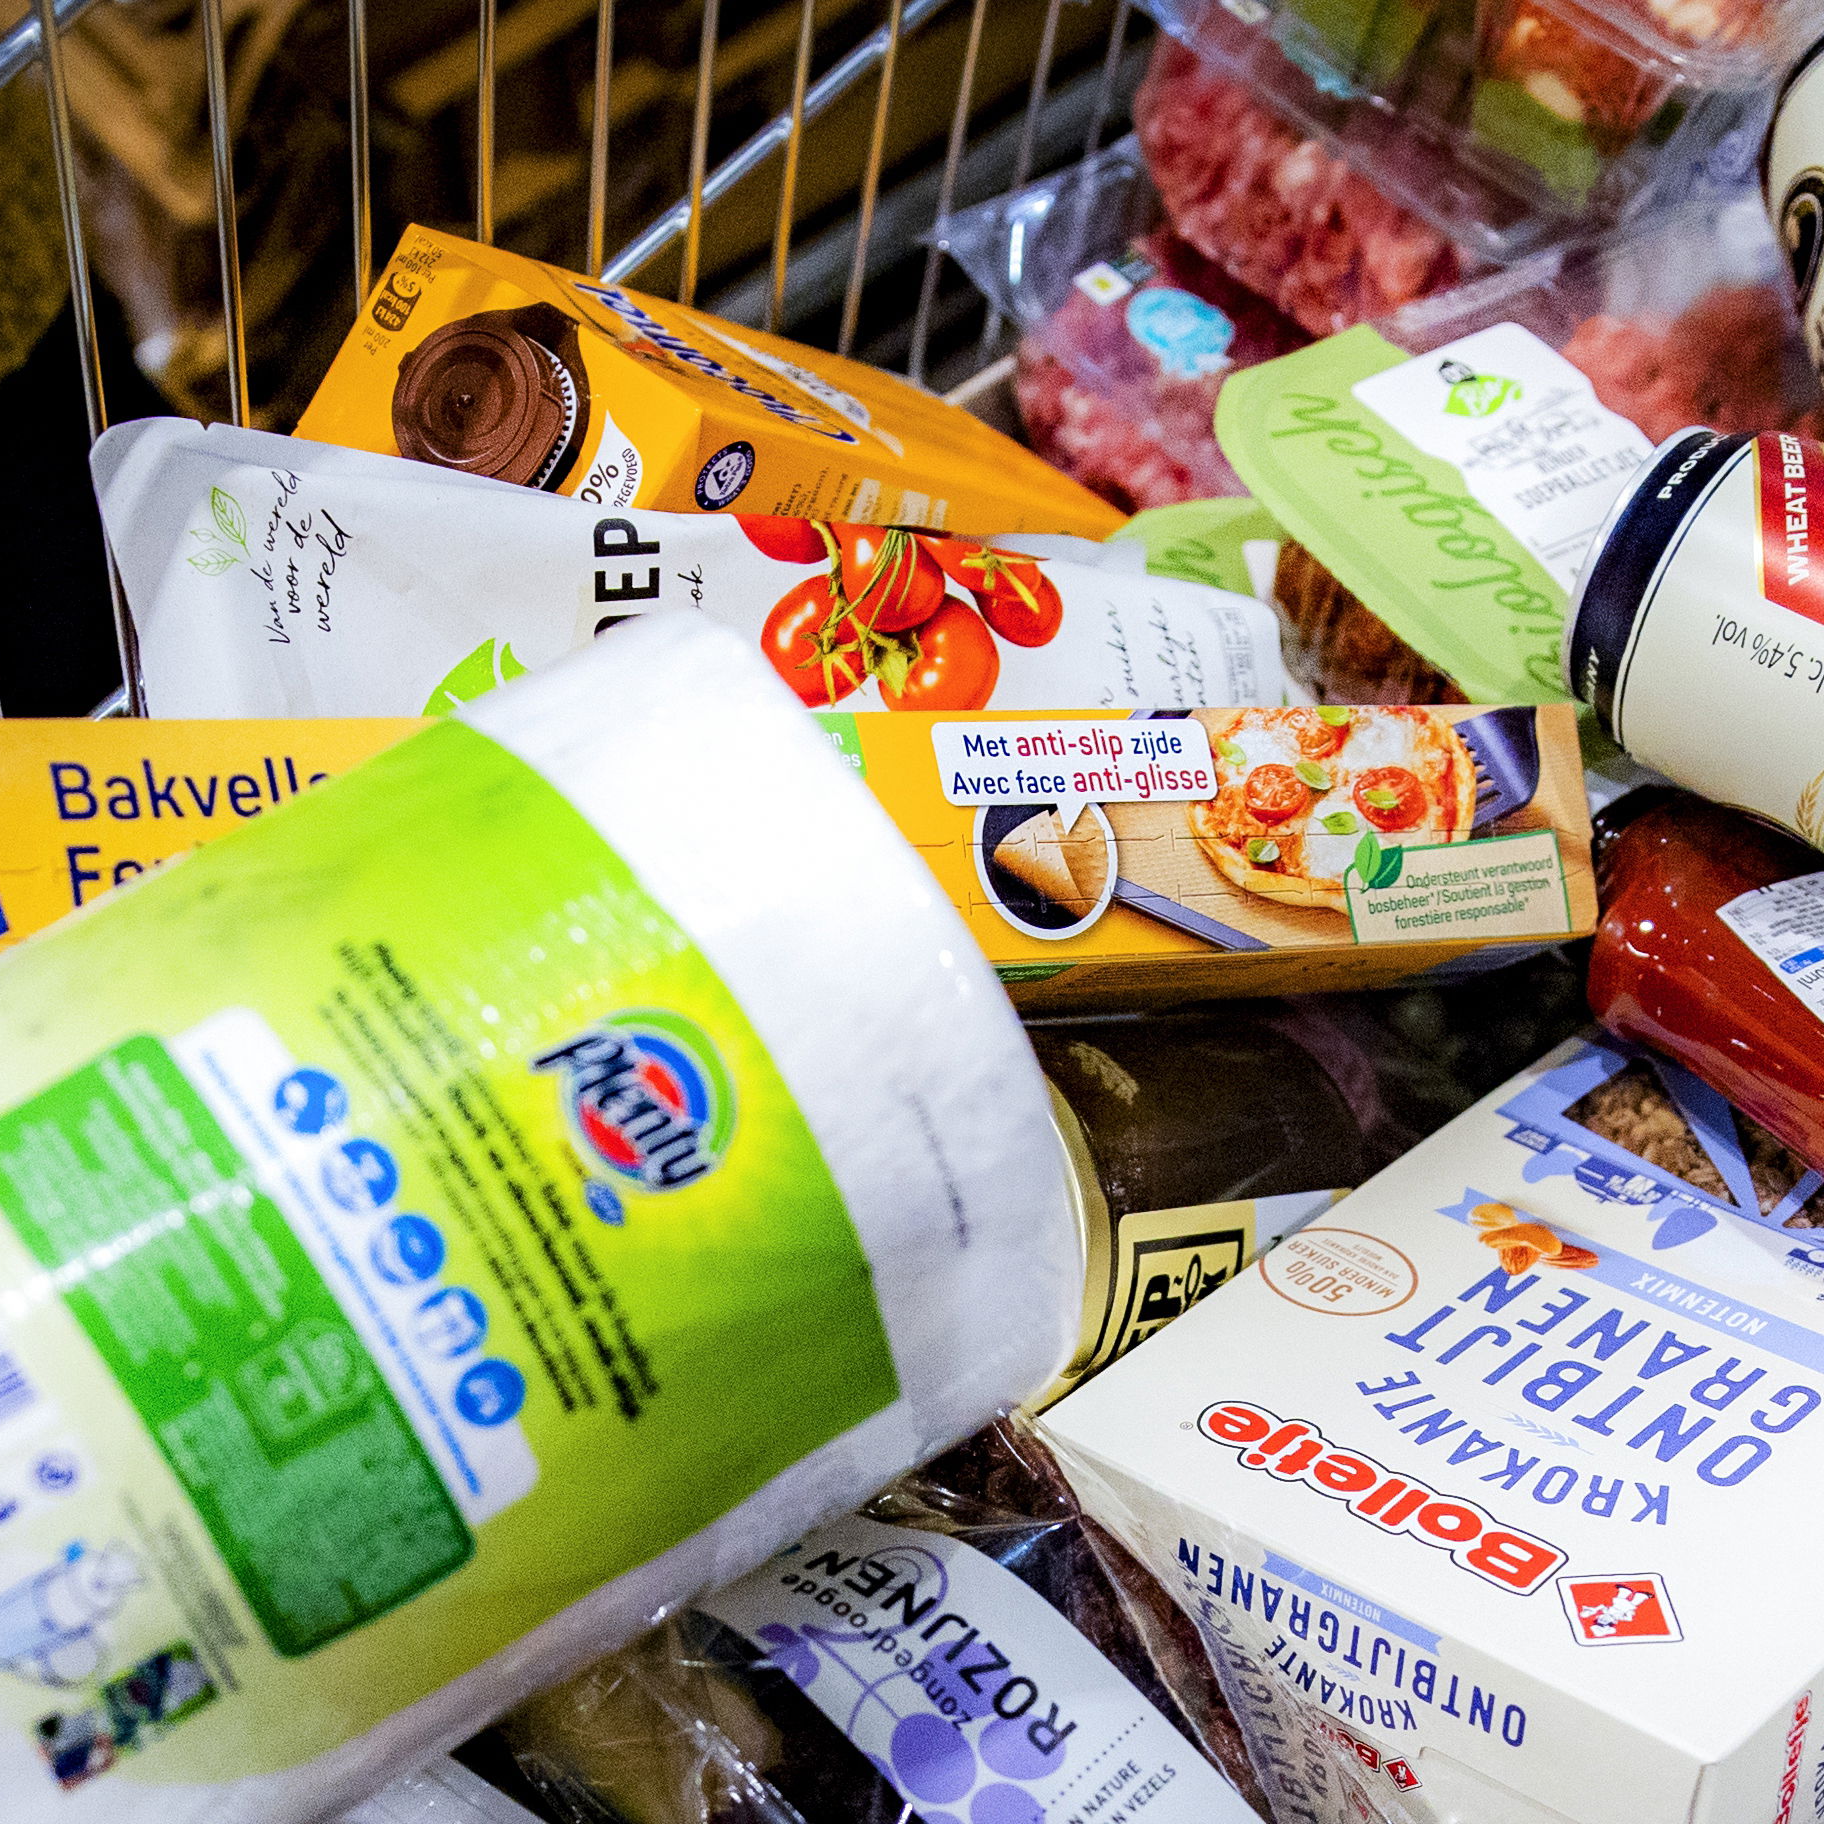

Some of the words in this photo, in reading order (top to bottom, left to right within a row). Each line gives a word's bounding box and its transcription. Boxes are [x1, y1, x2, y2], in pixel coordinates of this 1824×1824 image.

[613, 446, 639, 510] OEGEVOEGD
[1777, 433, 1807, 478] BEER
[263, 468, 303, 552] wereld
[284, 511, 313, 550] de
[1784, 483, 1813, 587] WHEAT
[249, 559, 274, 592] de
[284, 556, 302, 614] voor
[314, 507, 354, 633] wereld
[263, 600, 291, 644] Van
[1710, 612, 1748, 648] vol.
[1749, 632, 1799, 679] 5,4%
[961, 732, 1011, 759] Met
[1015, 727, 1124, 763] anti-slip
[1130, 730, 1183, 761] zijde
[47, 755, 332, 821] Bakvell
[951, 770, 1011, 797] Avec
[1015, 768, 1067, 795] face
[1072, 763, 1209, 800] anti-glisse
[1405, 866, 1480, 890] Ondersteunt
[1482, 854, 1554, 879] verantwoord
[1494, 881, 1506, 896] la
[1507, 876, 1552, 899] gestion
[1394, 907, 1453, 931] forestière
[530, 1033, 711, 1189] Plenty
[1284, 1259, 1354, 1304] 50%
[1286, 1239, 1340, 1275] SUIKER
[1339, 1264, 1398, 1299] MINDER
[1630, 1270, 1771, 1337] NOTENMIX
[1456, 1267, 1824, 1434] GRANEN
[1383, 1305, 1774, 1488] ONTBIJT
[1355, 1369, 1671, 1527] KROKANTE
[1201, 1402, 1567, 1593] Bolletje
[1319, 1581, 1382, 1622] NOTENMIX
[780, 1572, 974, 1733] zongedroogde
[803, 1549, 1078, 1756] ROZIJNEN
[1178, 1537, 1527, 1748] ONTBIJTGRANEN
[1264, 1634, 1418, 1731] KROKANTE
[1084, 1759, 1142, 1817] NATURE
[1123, 1763, 1179, 1818] VEZELS
